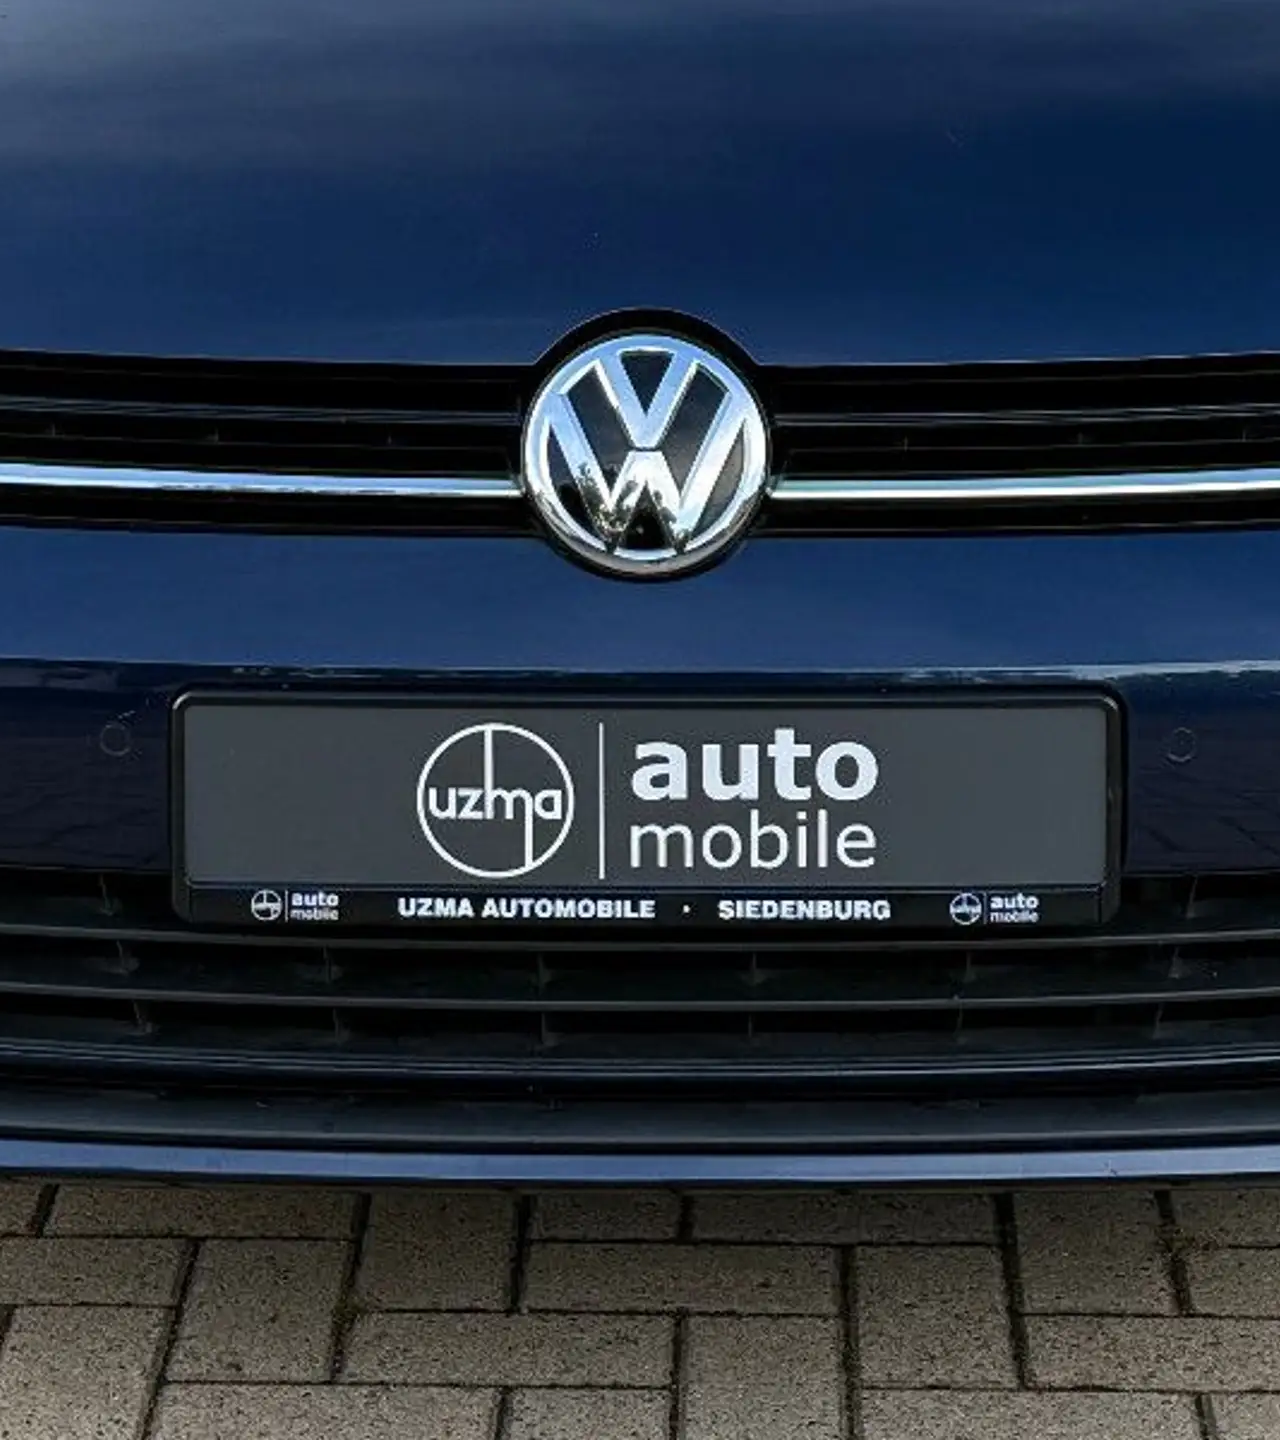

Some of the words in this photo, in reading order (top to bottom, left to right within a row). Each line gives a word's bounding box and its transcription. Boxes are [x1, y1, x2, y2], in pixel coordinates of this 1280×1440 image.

[631, 728, 879, 801] auto
[630, 808, 876, 870] mobile
[291, 891, 339, 906] auto
[398, 898, 475, 918] UZMA
[481, 899, 656, 919] AUTOMOBILE
[717, 900, 891, 920] SIEDENBURG
[990, 892, 1039, 909] auto
